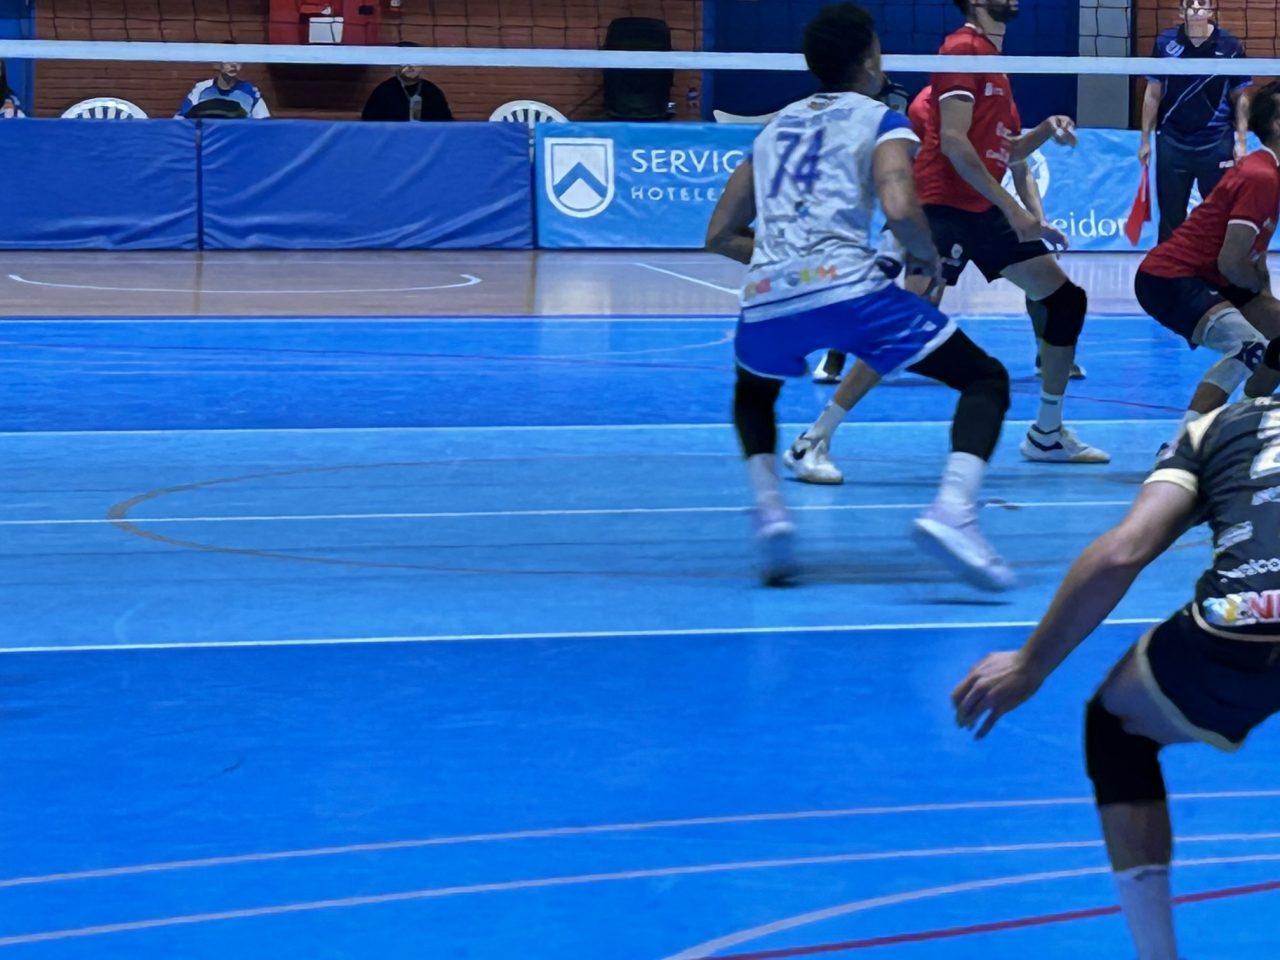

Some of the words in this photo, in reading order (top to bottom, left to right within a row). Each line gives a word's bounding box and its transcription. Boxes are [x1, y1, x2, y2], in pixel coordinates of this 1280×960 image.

[631, 149, 744, 173] SERVIG
[768, 127, 827, 198] 74
[631, 186, 725, 201] HOTELE
